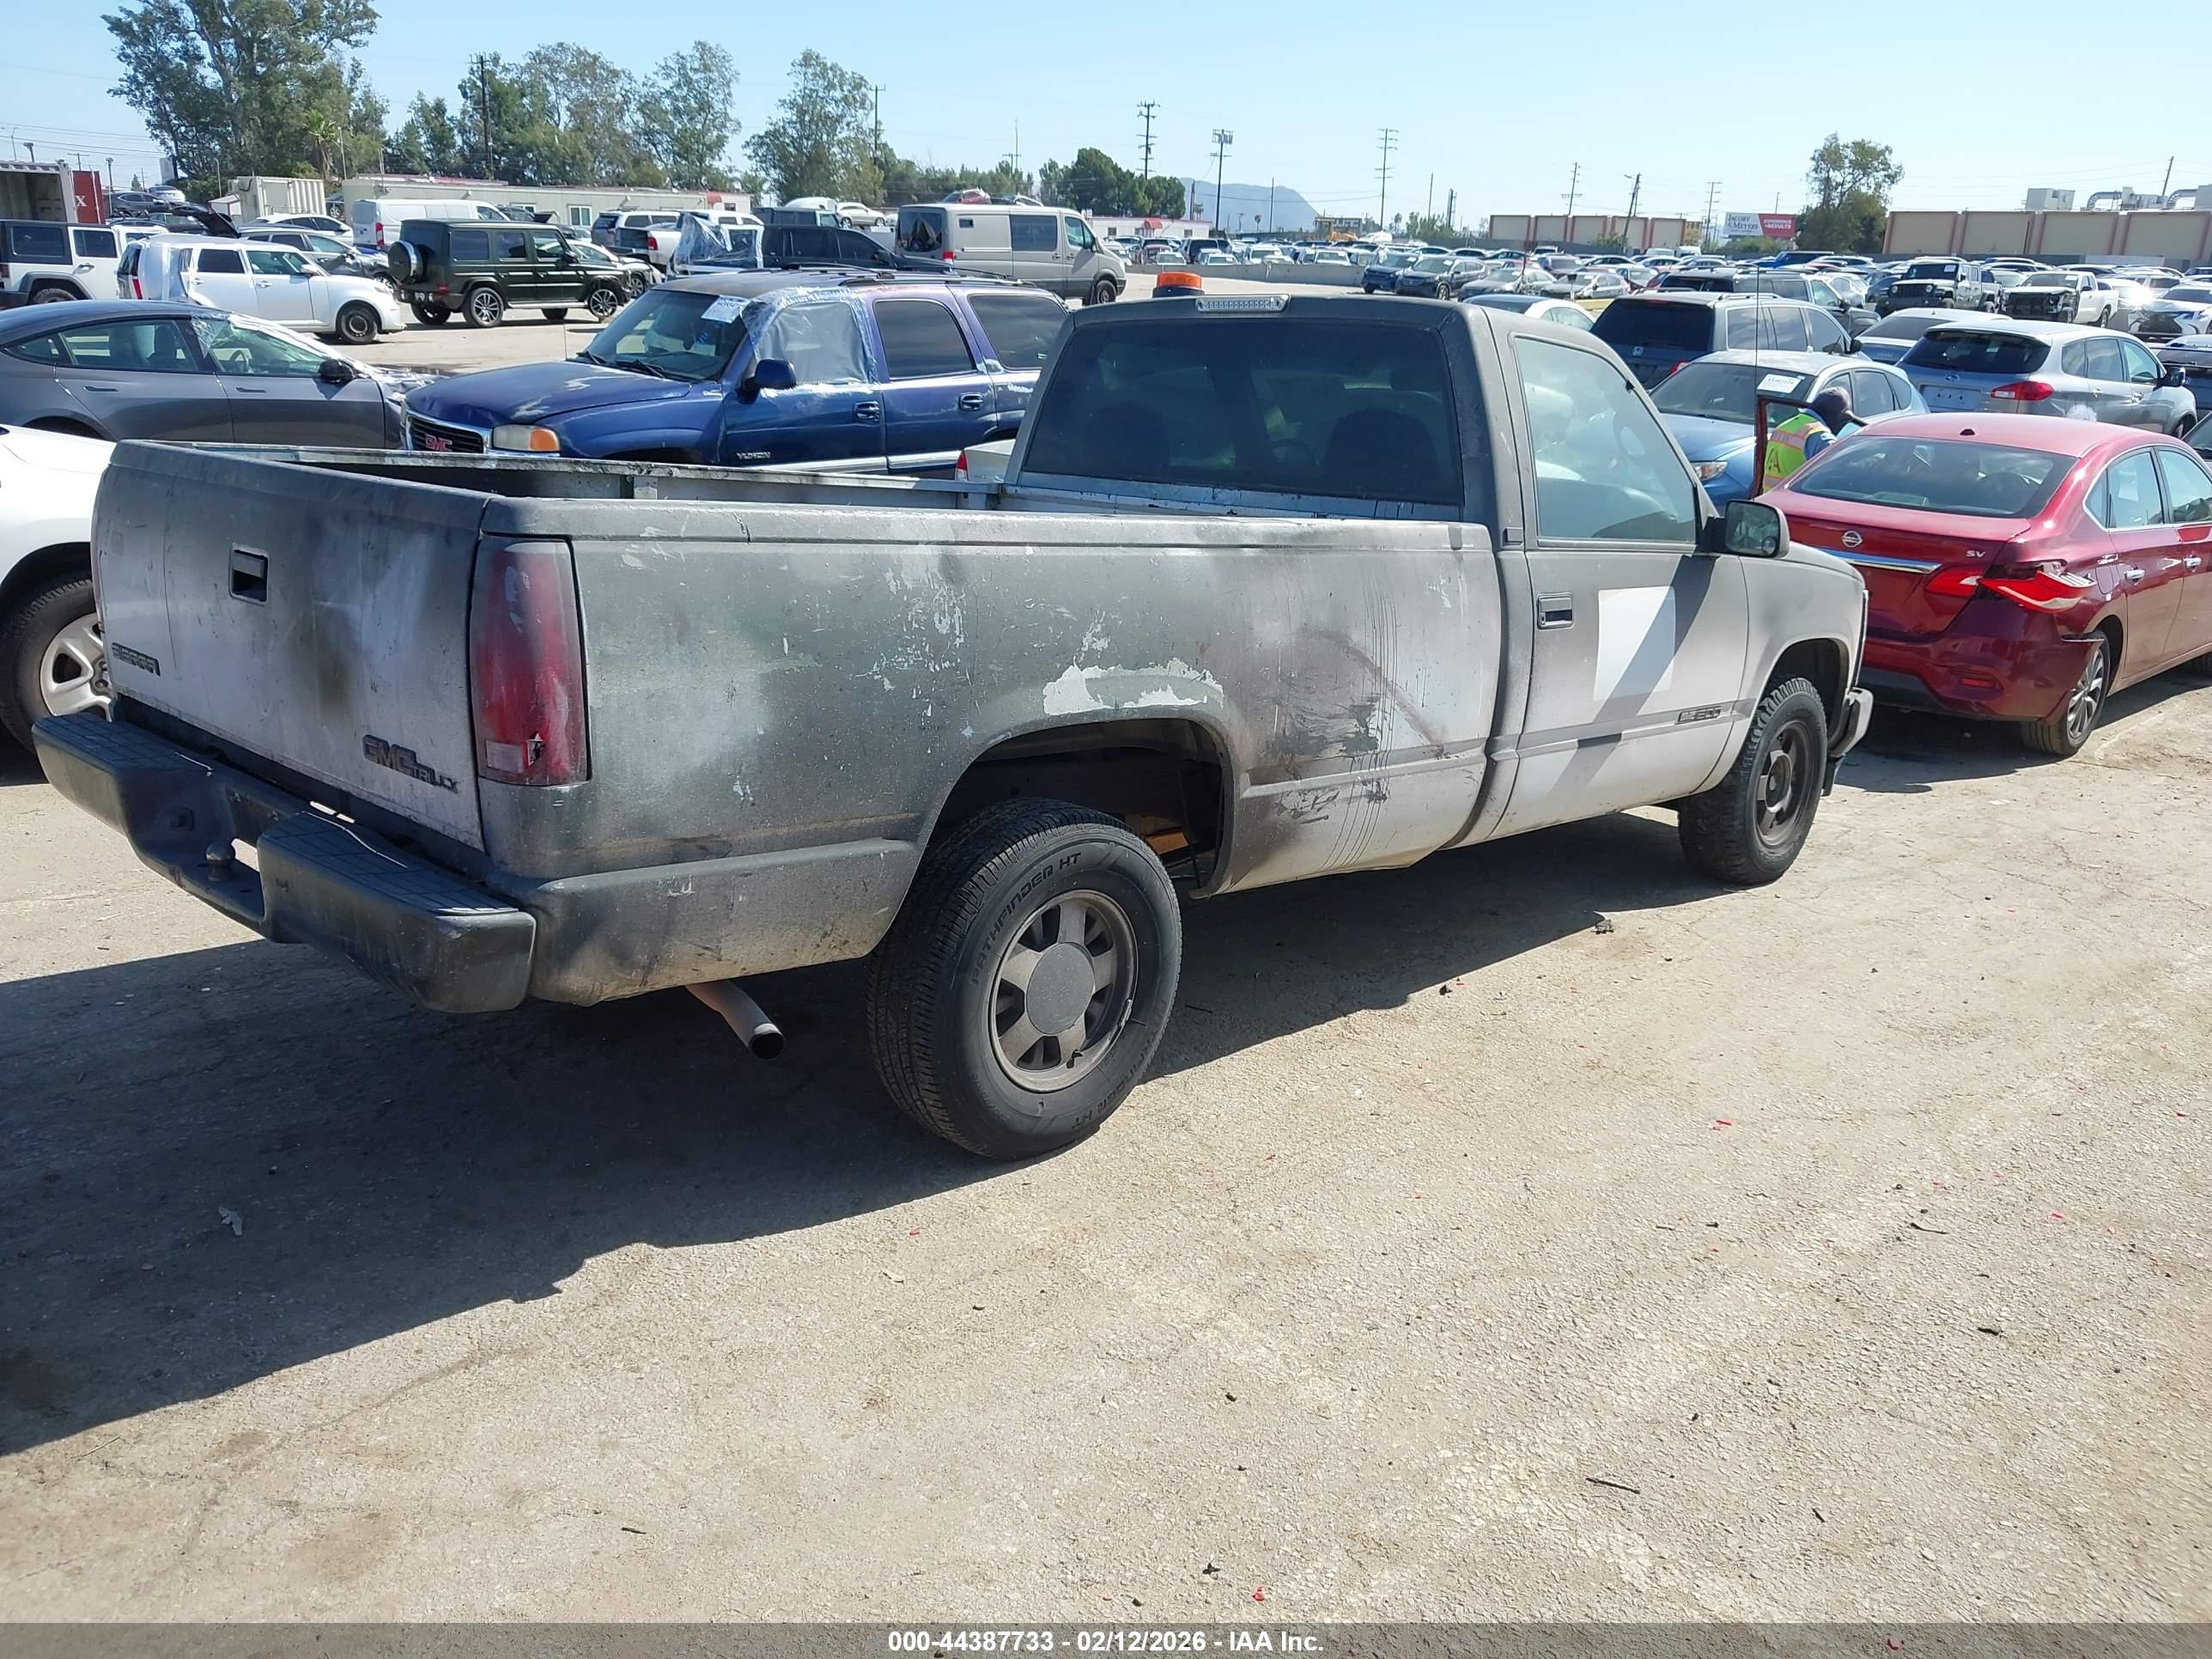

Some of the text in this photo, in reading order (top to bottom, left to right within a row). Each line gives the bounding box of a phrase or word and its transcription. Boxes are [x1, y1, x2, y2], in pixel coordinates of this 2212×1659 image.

[425, 434, 453, 452] GMC
[362, 734, 417, 778] GMC
[971, 852, 1081, 986] PATHFINDER HT
